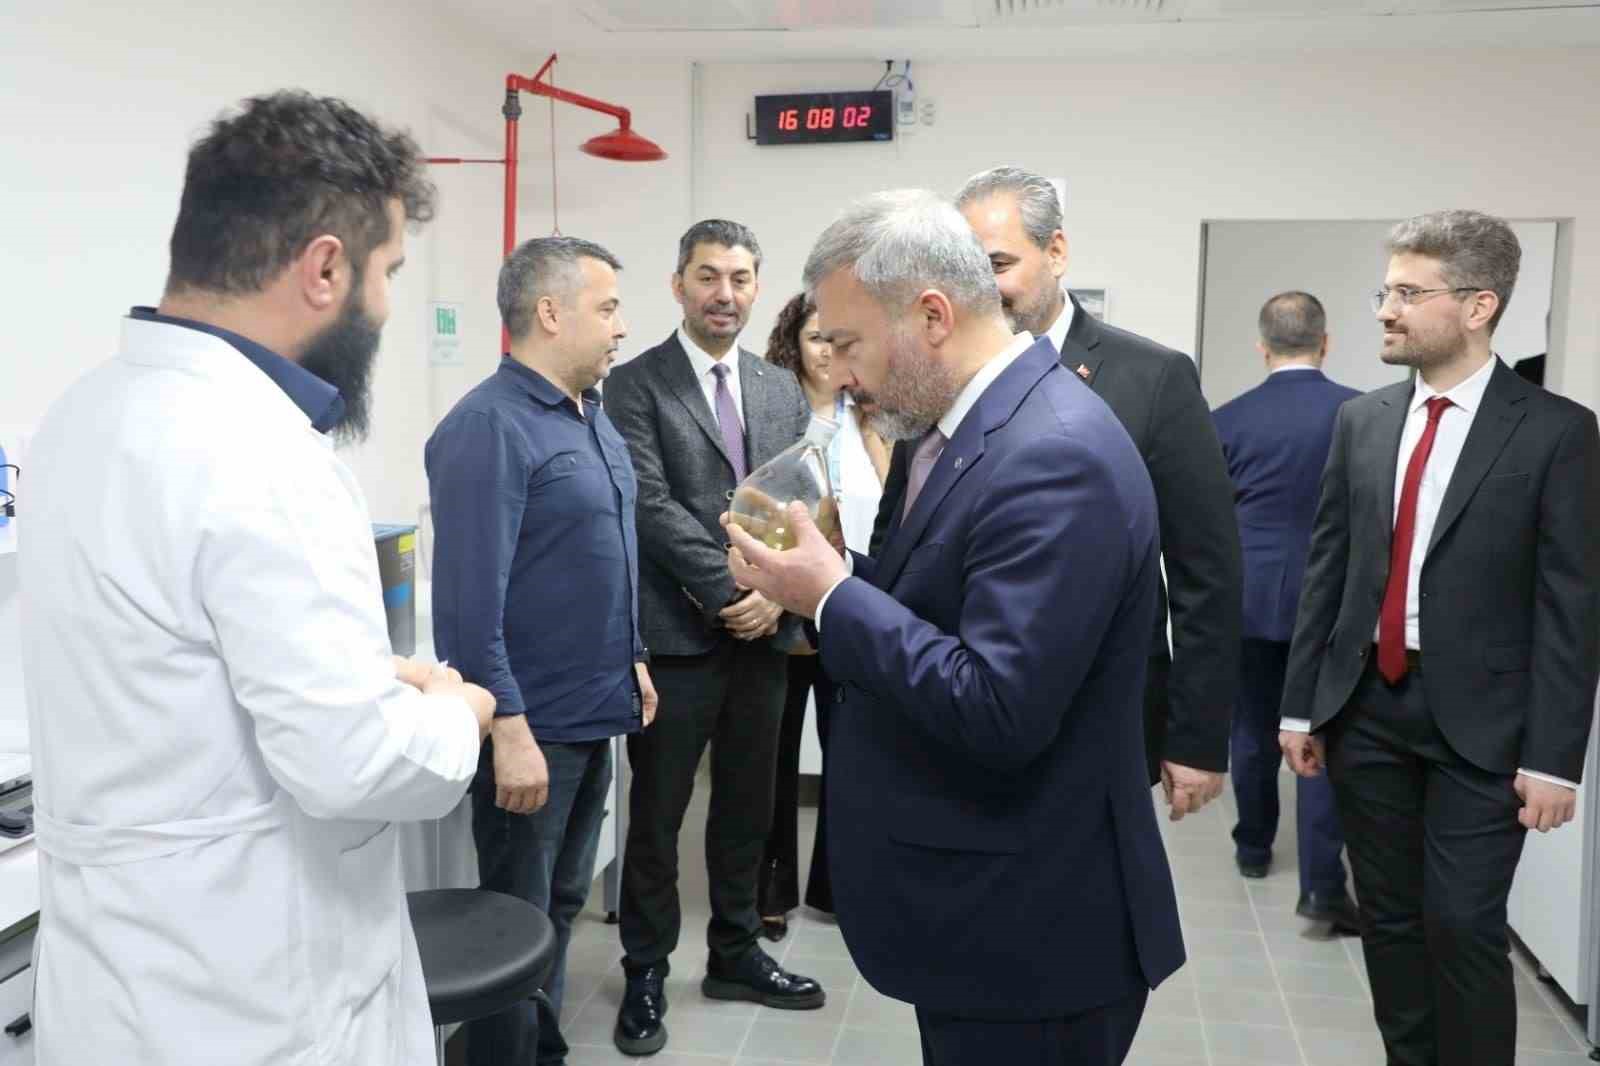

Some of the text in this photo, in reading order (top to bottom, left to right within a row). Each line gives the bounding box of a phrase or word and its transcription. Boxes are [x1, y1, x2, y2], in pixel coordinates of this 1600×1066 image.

[778, 106, 871, 130] 16 08 02
